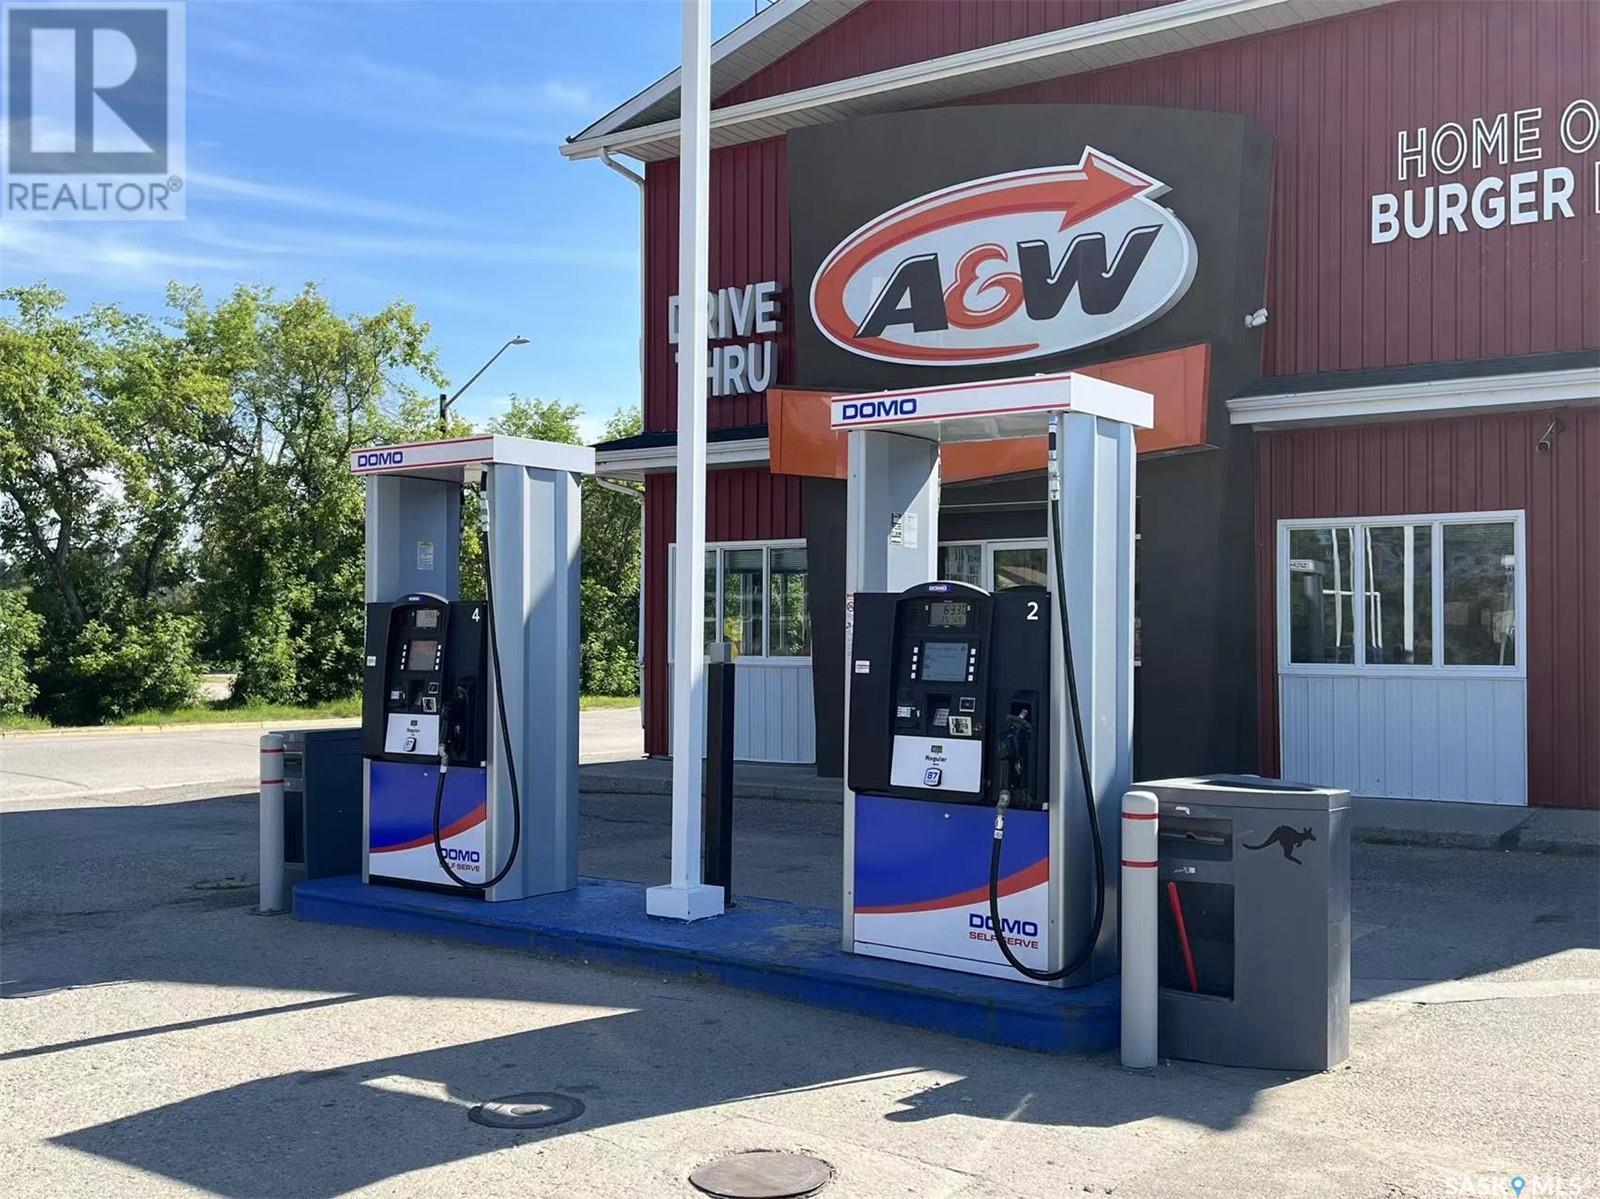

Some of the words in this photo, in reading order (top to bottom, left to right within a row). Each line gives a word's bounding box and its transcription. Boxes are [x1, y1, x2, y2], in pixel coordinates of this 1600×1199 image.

[1398, 107, 1542, 181] HOME
[1371, 166, 1575, 244] BURGER
[853, 223, 1164, 338] A&W
[842, 398, 918, 420] DOMO
[357, 451, 403, 467] DOMO
[471, 607, 481, 623] 4
[1026, 601, 1039, 620] 2
[925, 755, 947, 763] Regular
[926, 771, 939, 780] 87
